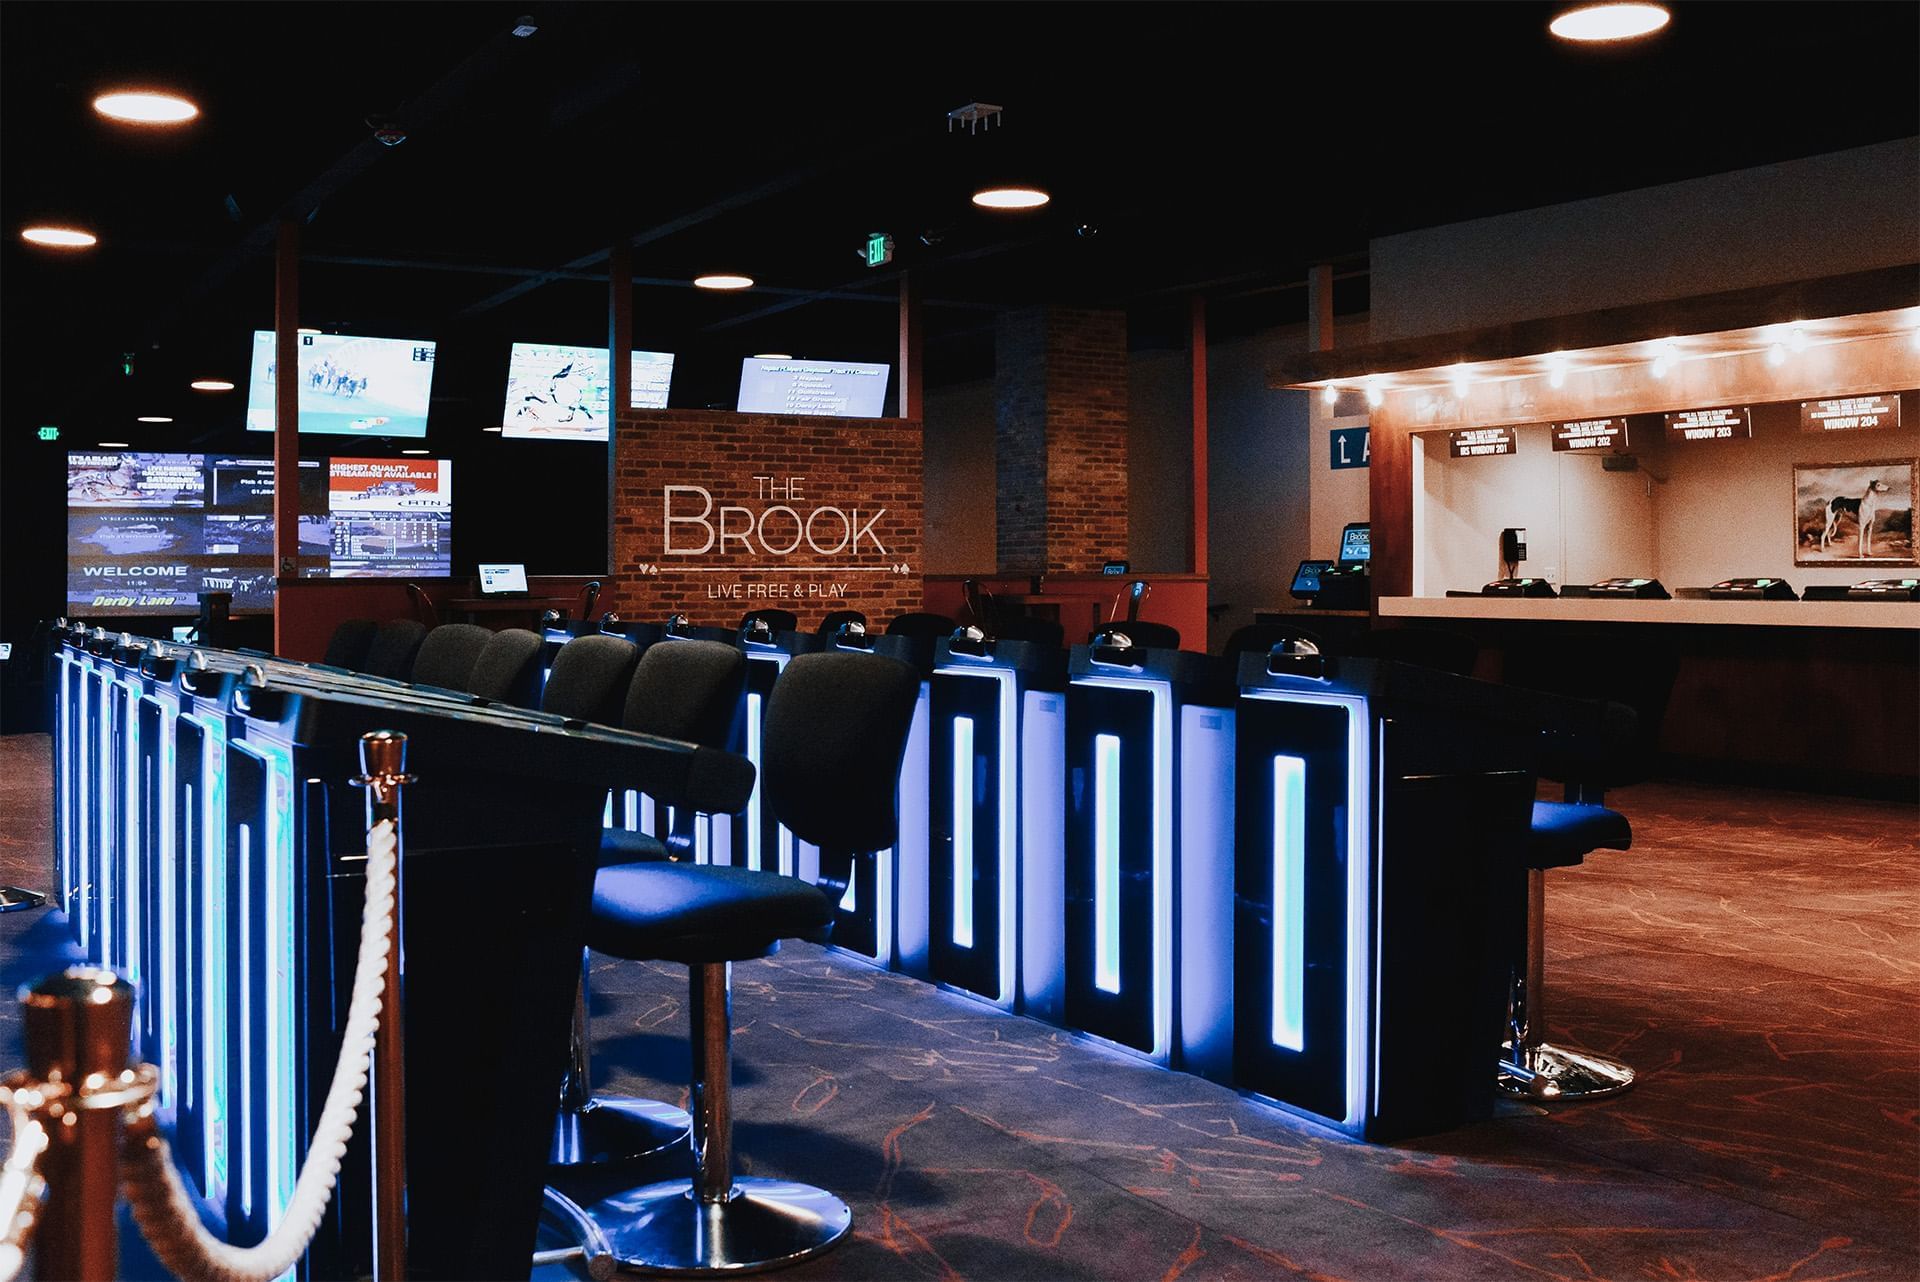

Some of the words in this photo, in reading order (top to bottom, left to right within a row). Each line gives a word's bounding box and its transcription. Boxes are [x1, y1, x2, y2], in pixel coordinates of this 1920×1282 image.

[869, 236, 884, 265] EXIT
[1823, 416, 1859, 430] WINDOW
[1860, 415, 1879, 427] 204
[1684, 427, 1716, 440] WINDOW
[1716, 426, 1732, 438] 203
[1470, 444, 1495, 455] WINDOW
[1495, 443, 1507, 454] 201
[1568, 437, 1597, 449] WINDOW
[1597, 436, 1611, 447] 202
[329, 463, 368, 471] HIGHEST
[369, 464, 409, 472] QUALITY
[329, 470, 382, 478] STREAMING
[383, 471, 432, 479] AVAILABLE
[753, 476, 806, 500] THE
[664, 485, 887, 555] BROOK
[83, 566, 188, 576] WELCOME
[708, 584, 742, 598] LIVE
[747, 584, 789, 598] FREE
[793, 584, 804, 597] &
[808, 583, 848, 598] PLAY
[92, 595, 137, 607] Derby
[138, 595, 176, 606] Lane
